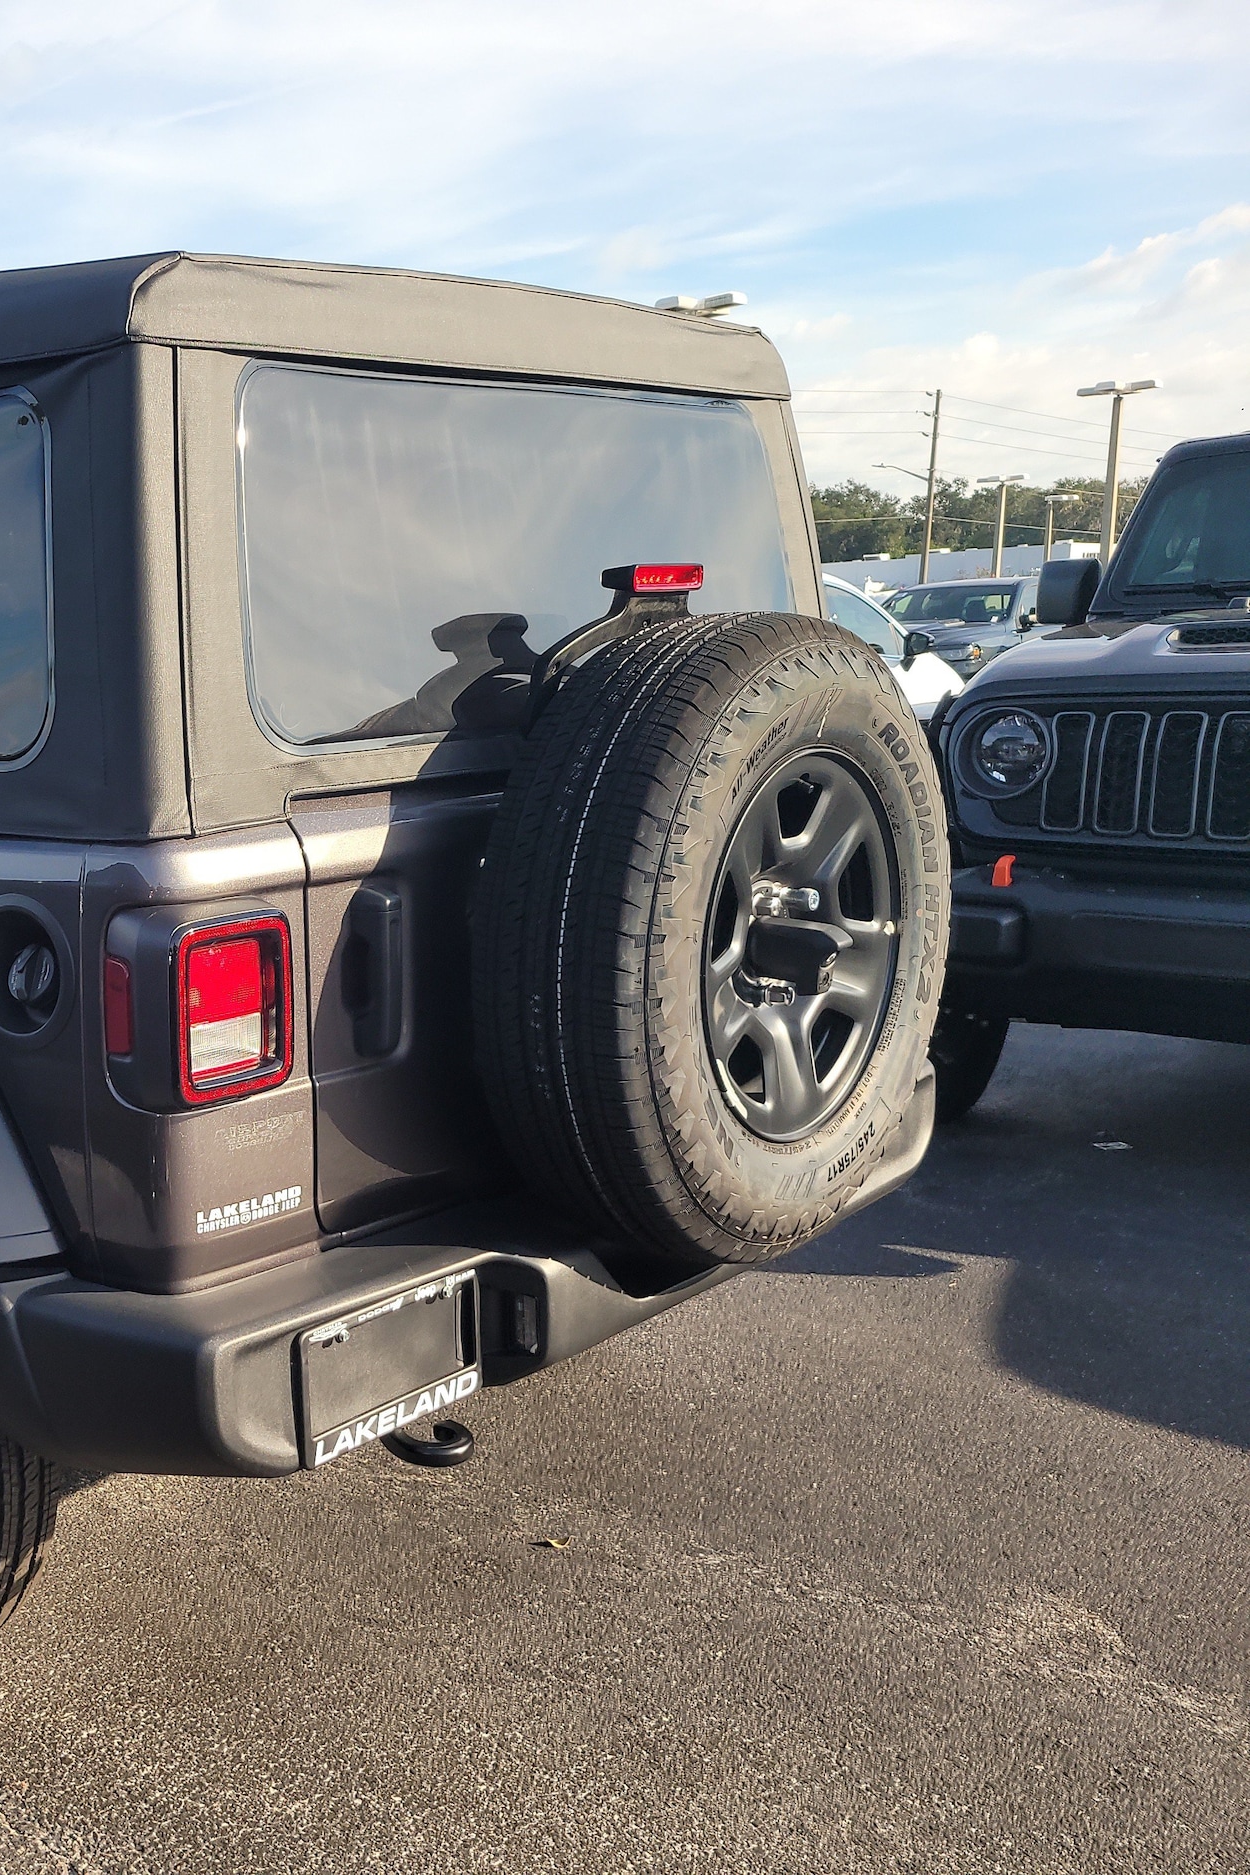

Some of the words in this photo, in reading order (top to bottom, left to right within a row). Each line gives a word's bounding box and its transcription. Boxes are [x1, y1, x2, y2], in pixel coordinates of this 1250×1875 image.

[731, 716, 790, 804] All-Weather
[876, 722, 939, 873] ROADIAN
[915, 883, 941, 1005] HTX2
[827, 1120, 876, 1183] 245/75R17
[196, 1185, 302, 1223] LAKELAND
[196, 1214, 240, 1234] CHRYSLER
[251, 1203, 280, 1221] DODGE
[281, 1197, 301, 1212] JEEP
[414, 1284, 437, 1302] Jeep
[315, 1370, 478, 1467] LAKELAND
